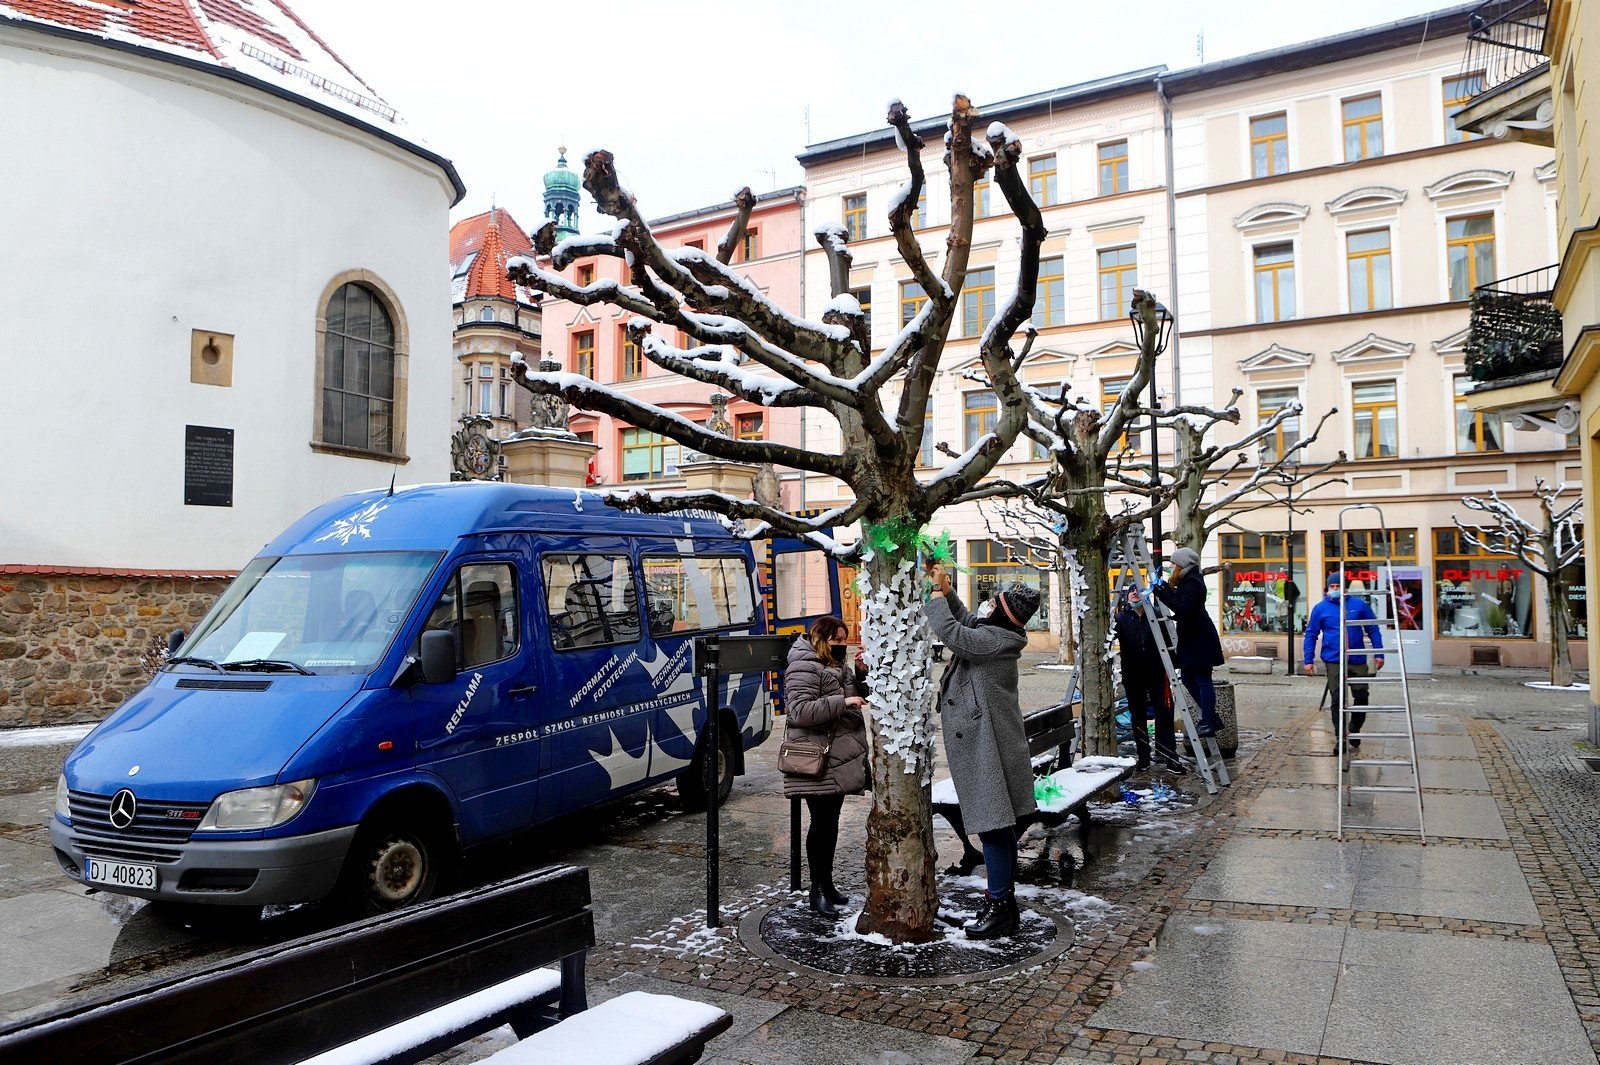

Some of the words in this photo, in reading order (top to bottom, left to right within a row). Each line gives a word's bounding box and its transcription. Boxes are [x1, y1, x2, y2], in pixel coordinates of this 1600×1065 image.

[1235, 571, 1292, 581] MODA
[1442, 569, 1523, 581] OUTLET
[569, 654, 620, 708] INFORMATYKA
[593, 649, 639, 703] FOTOTECHNIK
[651, 639, 690, 689] TECHNOLOGIA
[664, 656, 688, 688] DREWNA
[445, 672, 483, 735] REKLAMA
[495, 728, 539, 747] ZESPÓŁ
[582, 710, 626, 725] RZEMIOSŁ
[629, 692, 691, 714] ARTYSTYCZNYCH
[91, 862, 107, 881] DJ
[112, 865, 153, 886] 40823
